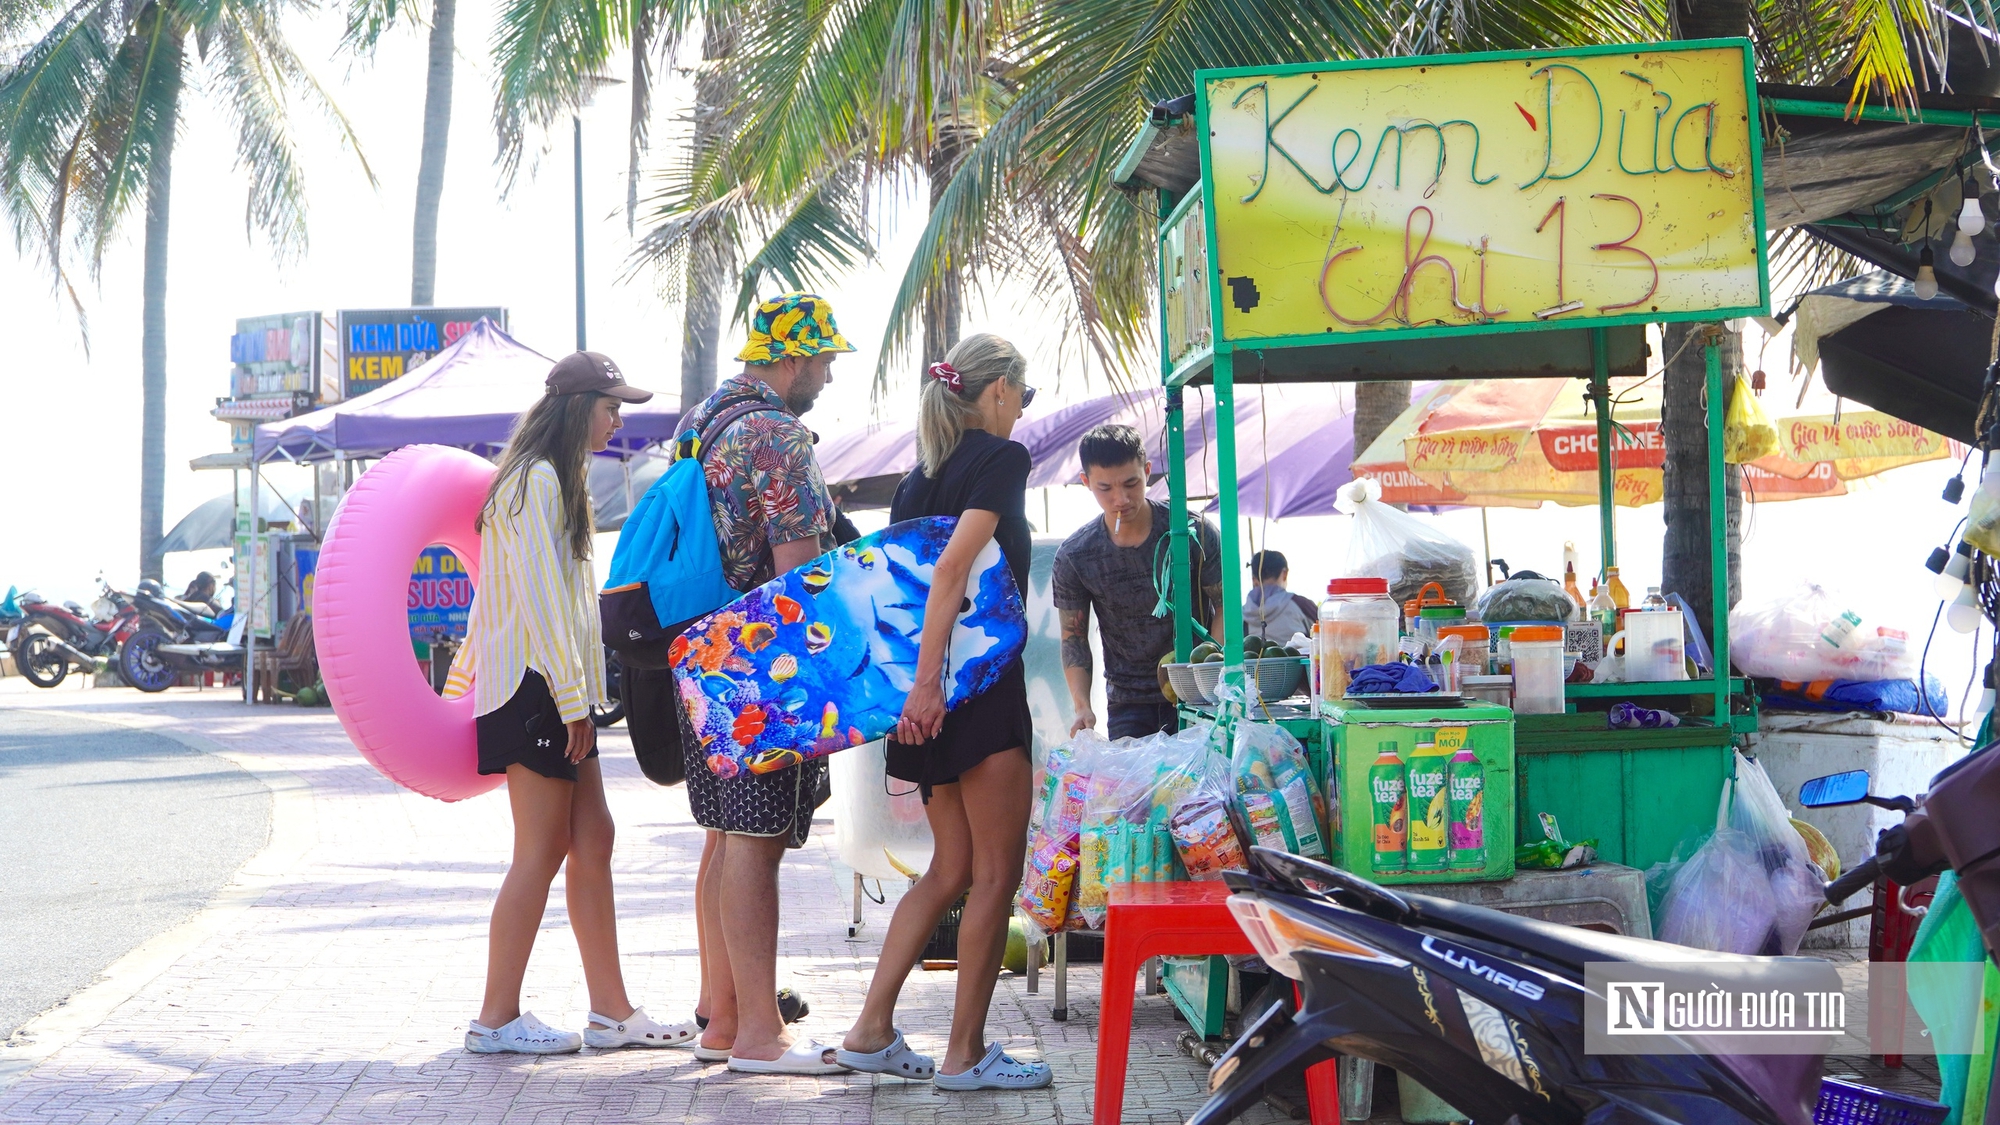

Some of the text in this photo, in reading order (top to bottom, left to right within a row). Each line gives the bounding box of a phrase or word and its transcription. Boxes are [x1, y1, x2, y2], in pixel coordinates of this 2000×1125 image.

[1233, 82, 1498, 203] Kem
[1536, 193, 1659, 320] 13
[349, 323, 395, 353] KEM
[349, 355, 403, 380] KEM
[1790, 421, 1818, 458] Gia
[1823, 423, 1840, 446] vị
[1846, 419, 1881, 444] cuộc
[1414, 435, 1519, 468] Gia vị cuộc sống
[407, 578, 471, 609] SUSU
[1438, 736, 1460, 748] MỚI
[1373, 776, 1404, 792] fuze
[1409, 769, 1443, 785] fuze
[1449, 773, 1480, 789] fuze
[1374, 790, 1398, 803] tea
[1411, 784, 1435, 798] tea
[1451, 787, 1473, 800] tea
